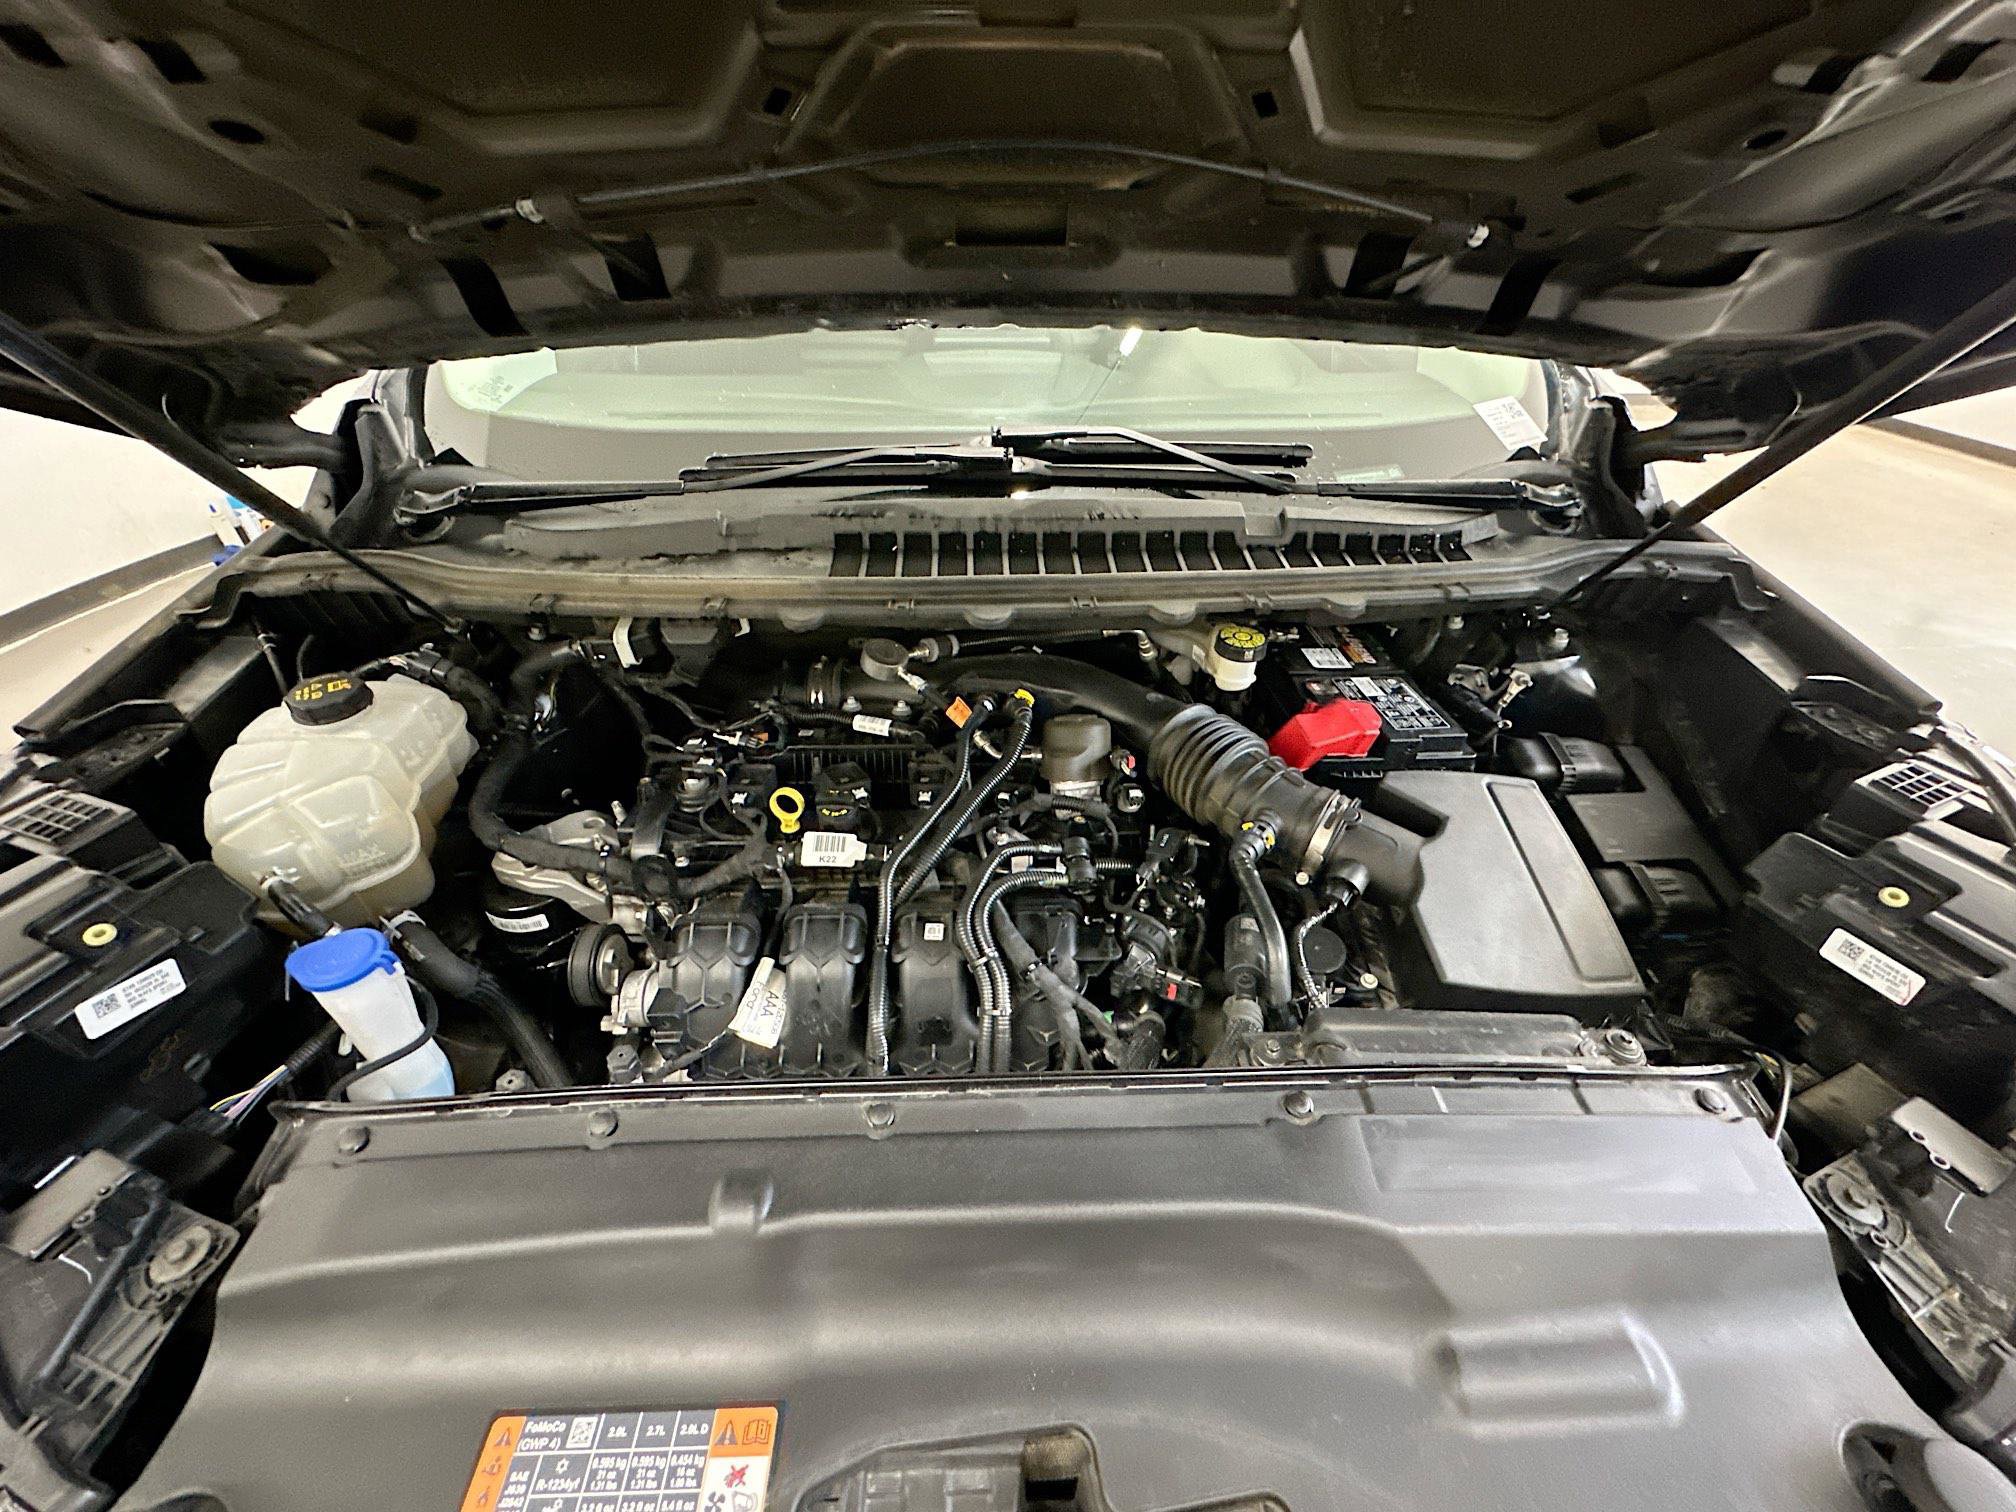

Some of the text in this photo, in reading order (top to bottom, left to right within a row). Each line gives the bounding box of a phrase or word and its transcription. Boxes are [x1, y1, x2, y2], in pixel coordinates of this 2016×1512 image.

[818, 855, 838, 864] K22
[760, 990, 779, 1017] AAA
[525, 1421, 567, 1433] FoMoCo
[607, 1426, 628, 1438] 2.0L
[517, 1438, 562, 1453] (GWP 4)
[616, 1456, 628, 1471] kg
[656, 1455, 667, 1470] kg
[694, 1454, 706, 1468] kg
[535, 1477, 581, 1493] R-1234yf
